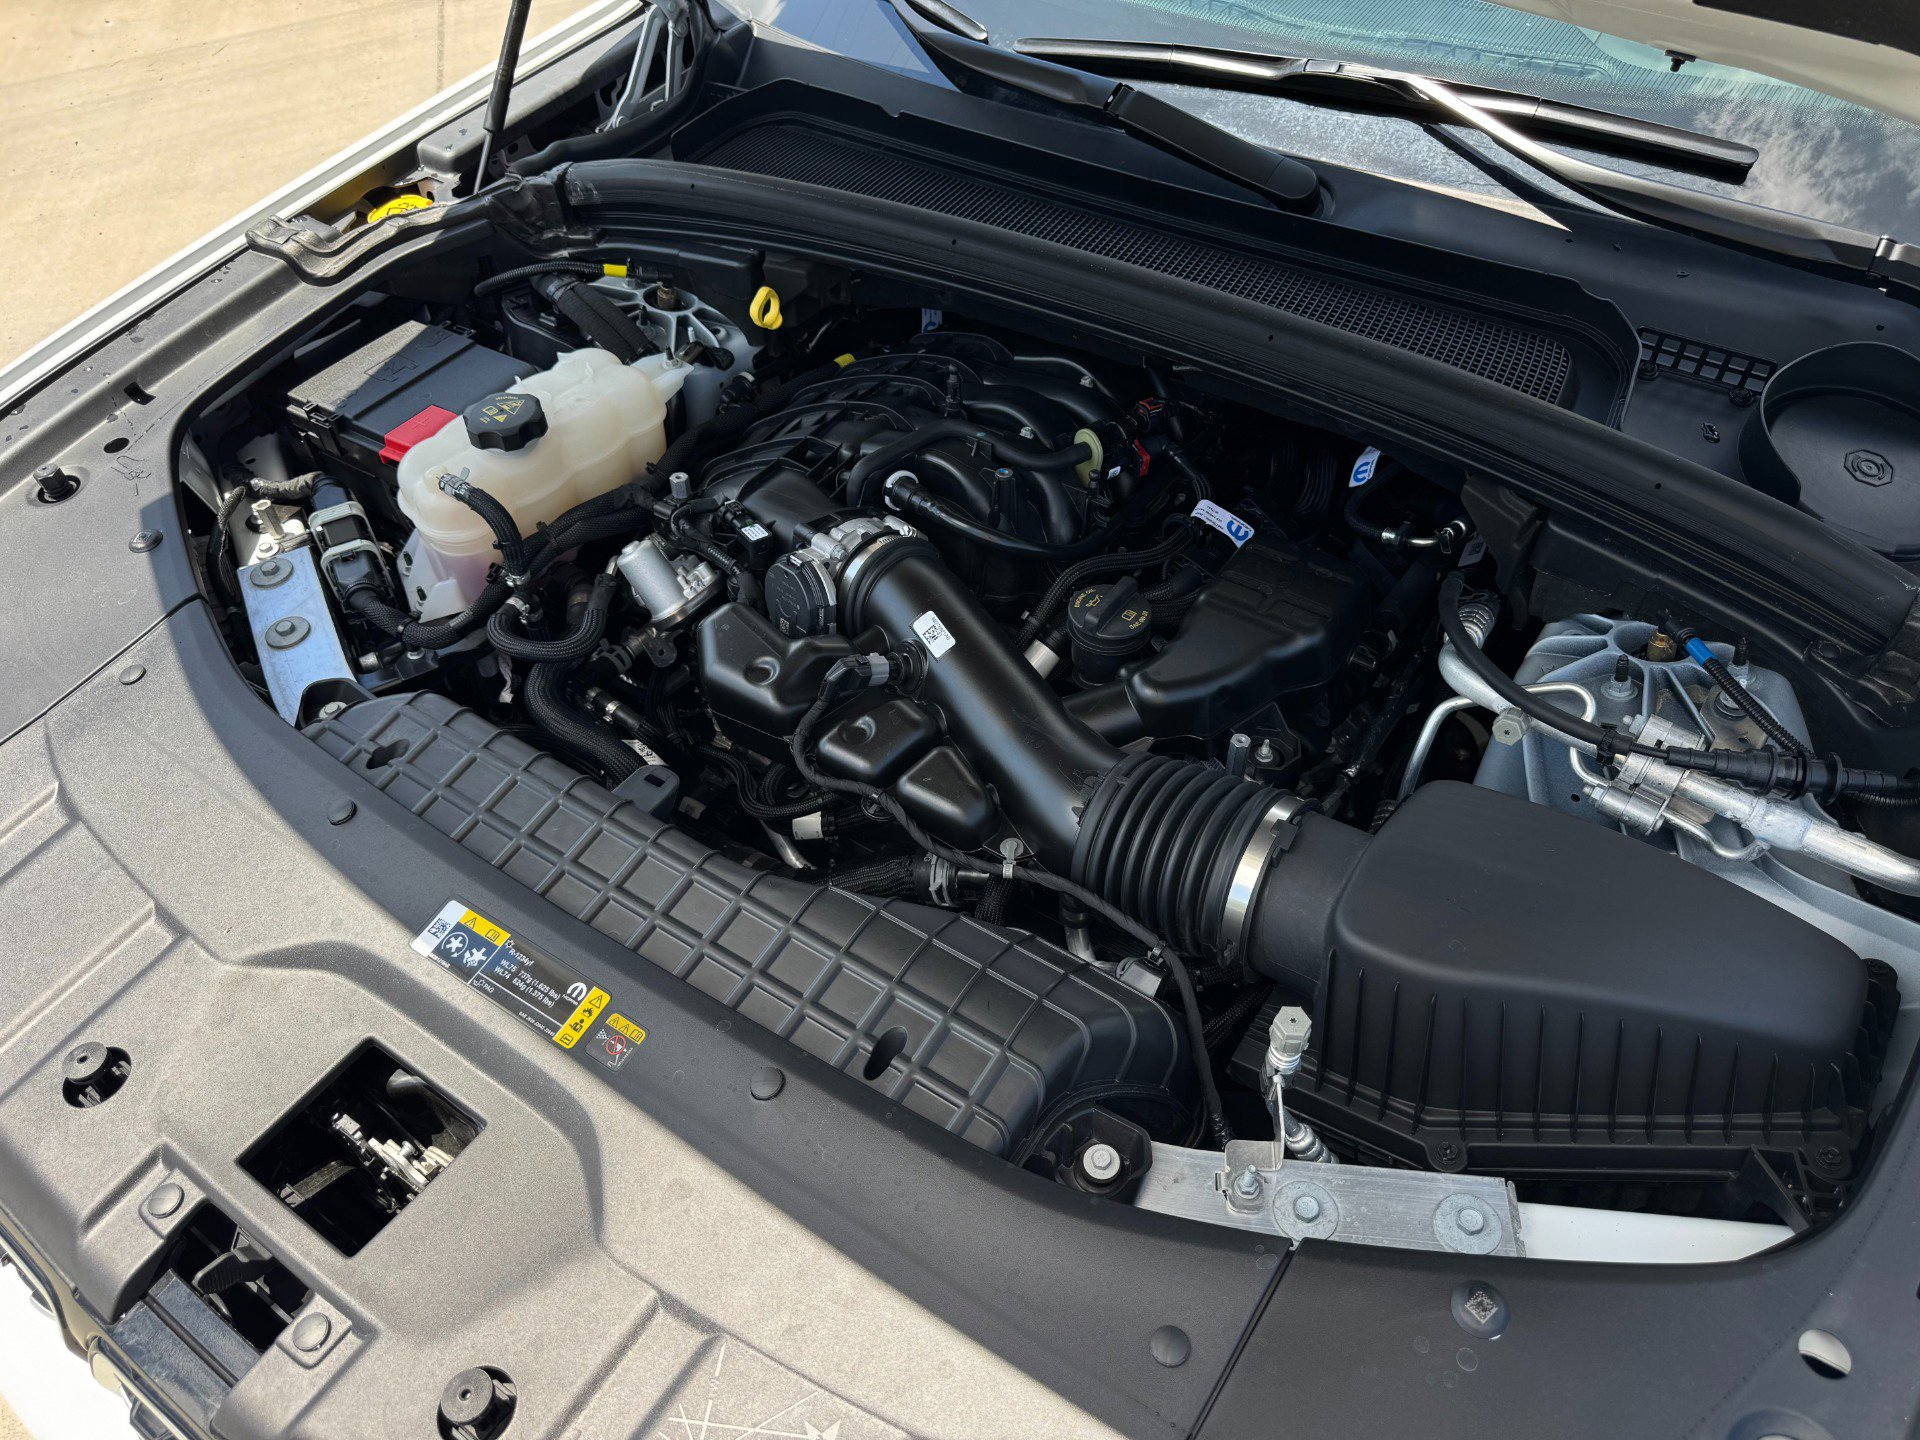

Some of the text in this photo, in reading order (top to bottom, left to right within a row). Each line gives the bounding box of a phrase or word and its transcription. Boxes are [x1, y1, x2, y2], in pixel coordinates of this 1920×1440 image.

[508, 948, 535, 967] R-1234yf
[482, 983, 495, 994] PAG
[494, 965, 555, 1008] WL74 624g (1.375 lbs)
[500, 958, 518, 972] WL75
[518, 970, 533, 984] 737g
[548, 988, 561, 1000] lbs)
